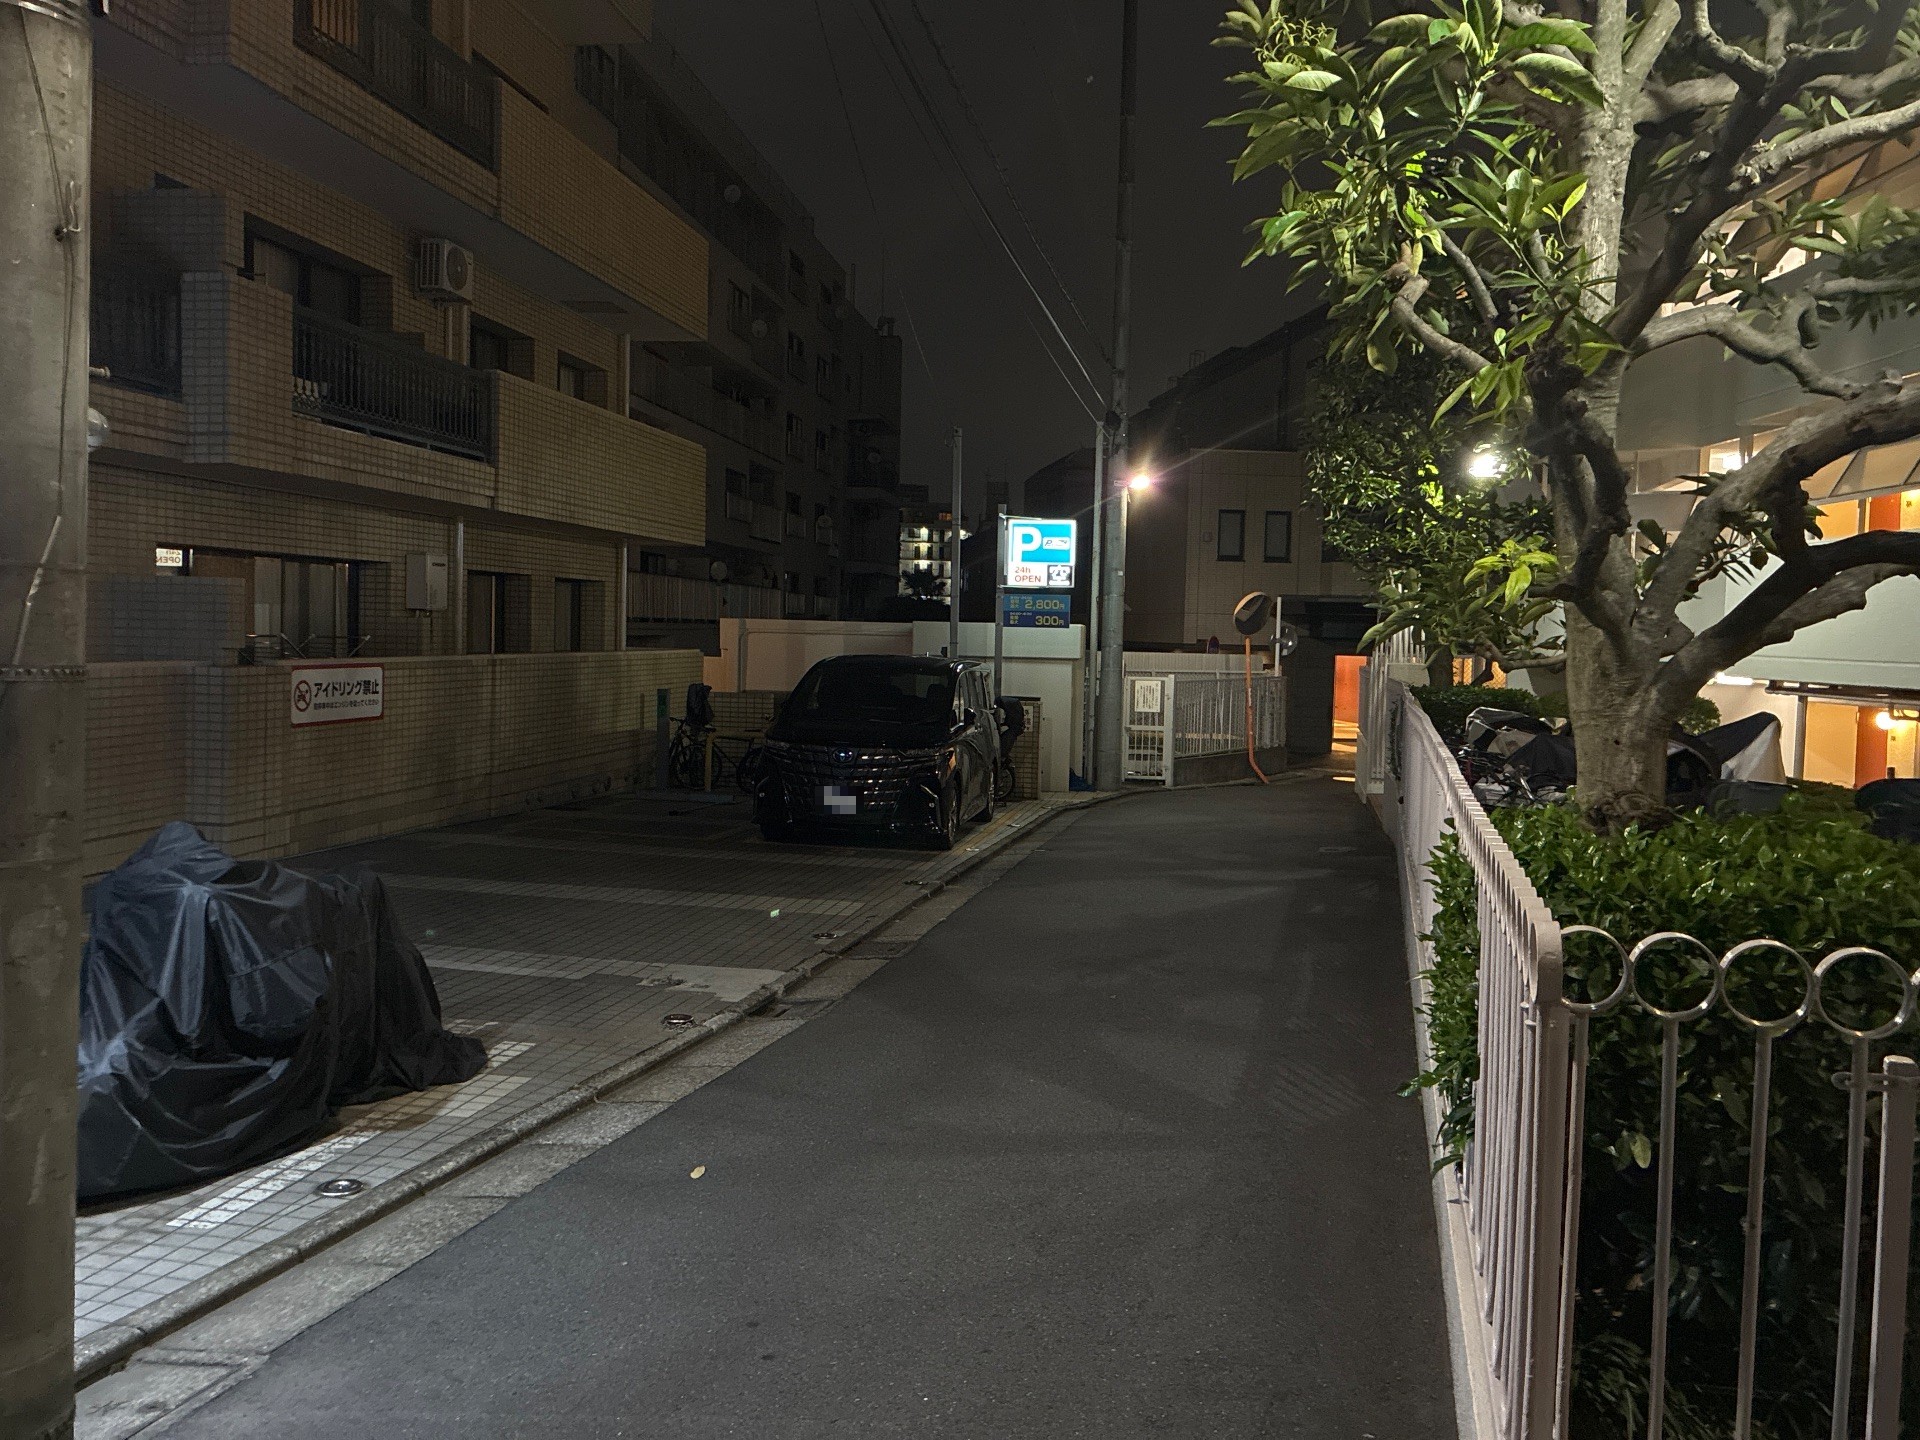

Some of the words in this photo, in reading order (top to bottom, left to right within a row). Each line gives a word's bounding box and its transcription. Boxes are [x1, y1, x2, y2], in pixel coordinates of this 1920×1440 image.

[1013, 526, 1042, 562] P
[1015, 575, 1041, 583] OPEN
[313, 679, 380, 698] アイドリング禁止
